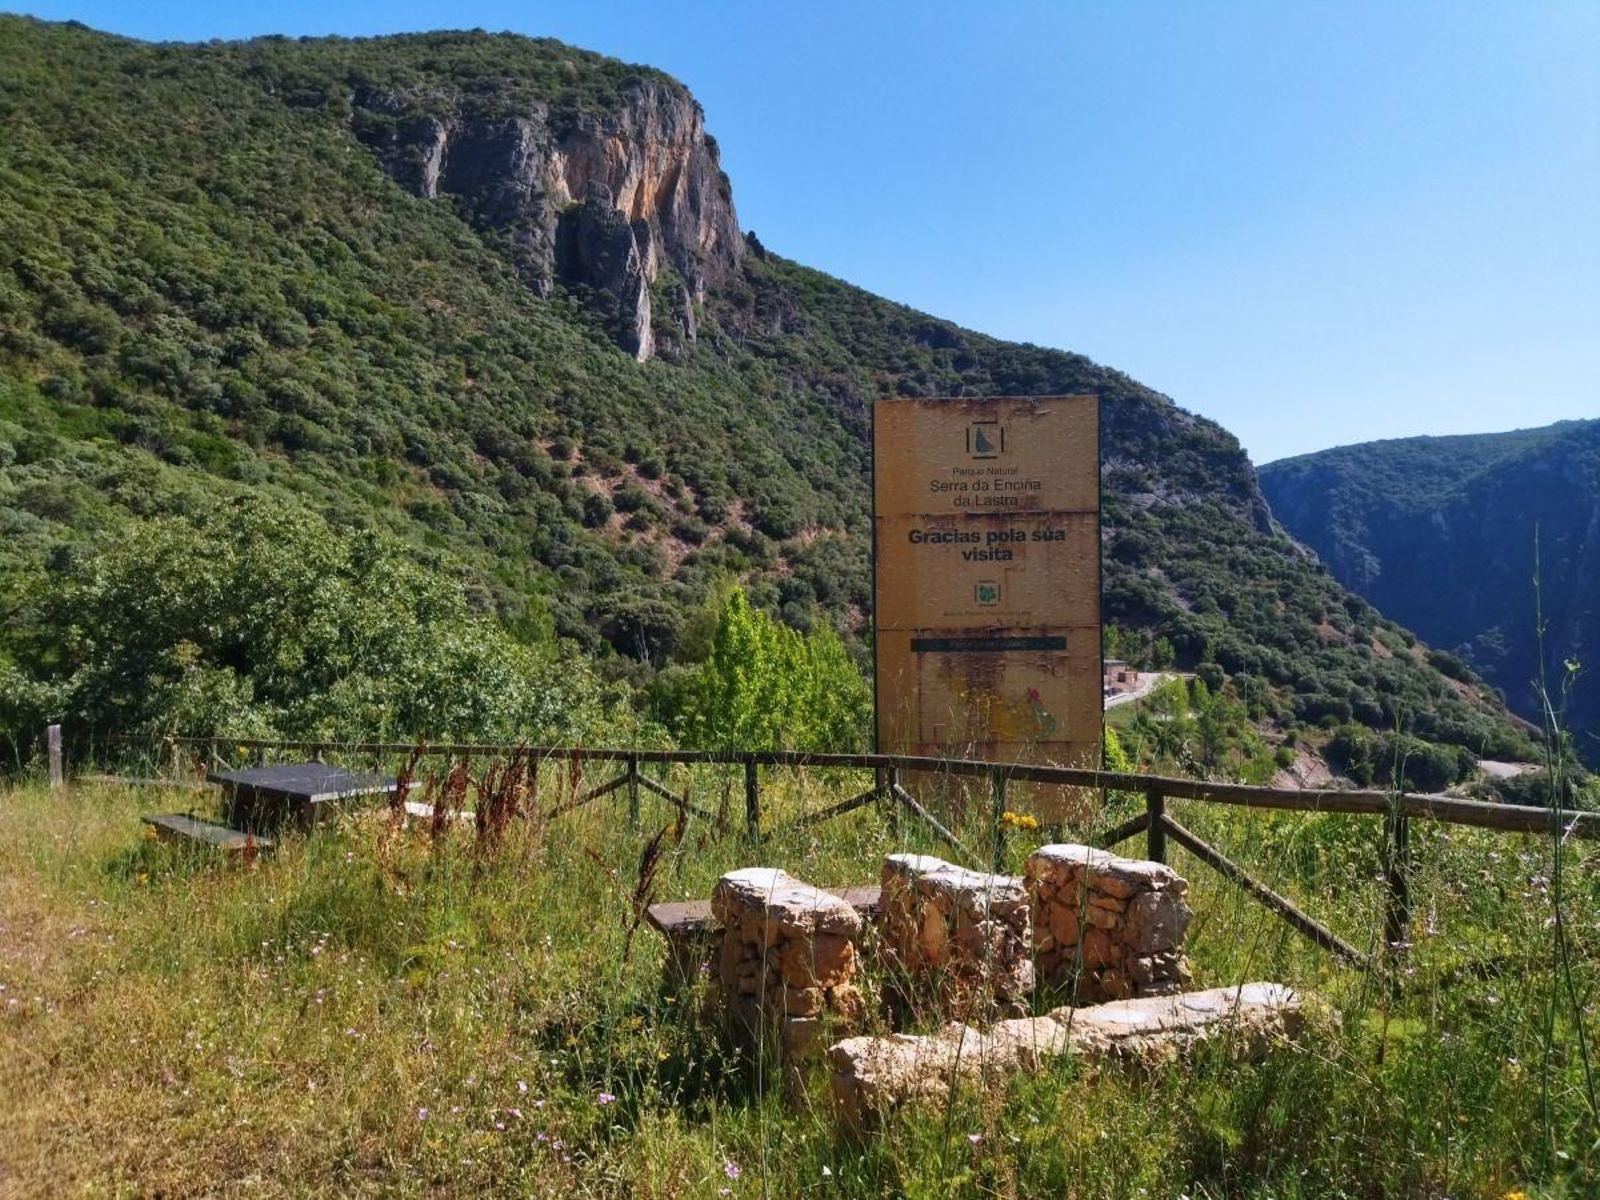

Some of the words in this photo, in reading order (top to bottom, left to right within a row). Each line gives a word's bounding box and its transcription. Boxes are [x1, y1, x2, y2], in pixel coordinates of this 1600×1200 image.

[952, 467, 984, 477] Parque
[987, 466, 1018, 475] Natural
[930, 479, 967, 492] Serra
[972, 479, 989, 491] da
[953, 495, 970, 507] da
[975, 494, 1018, 506] Lastra
[908, 529, 981, 544] Gracias
[986, 528, 1026, 545] pola
[1031, 527, 1066, 542] súa
[962, 546, 1013, 561] visita
